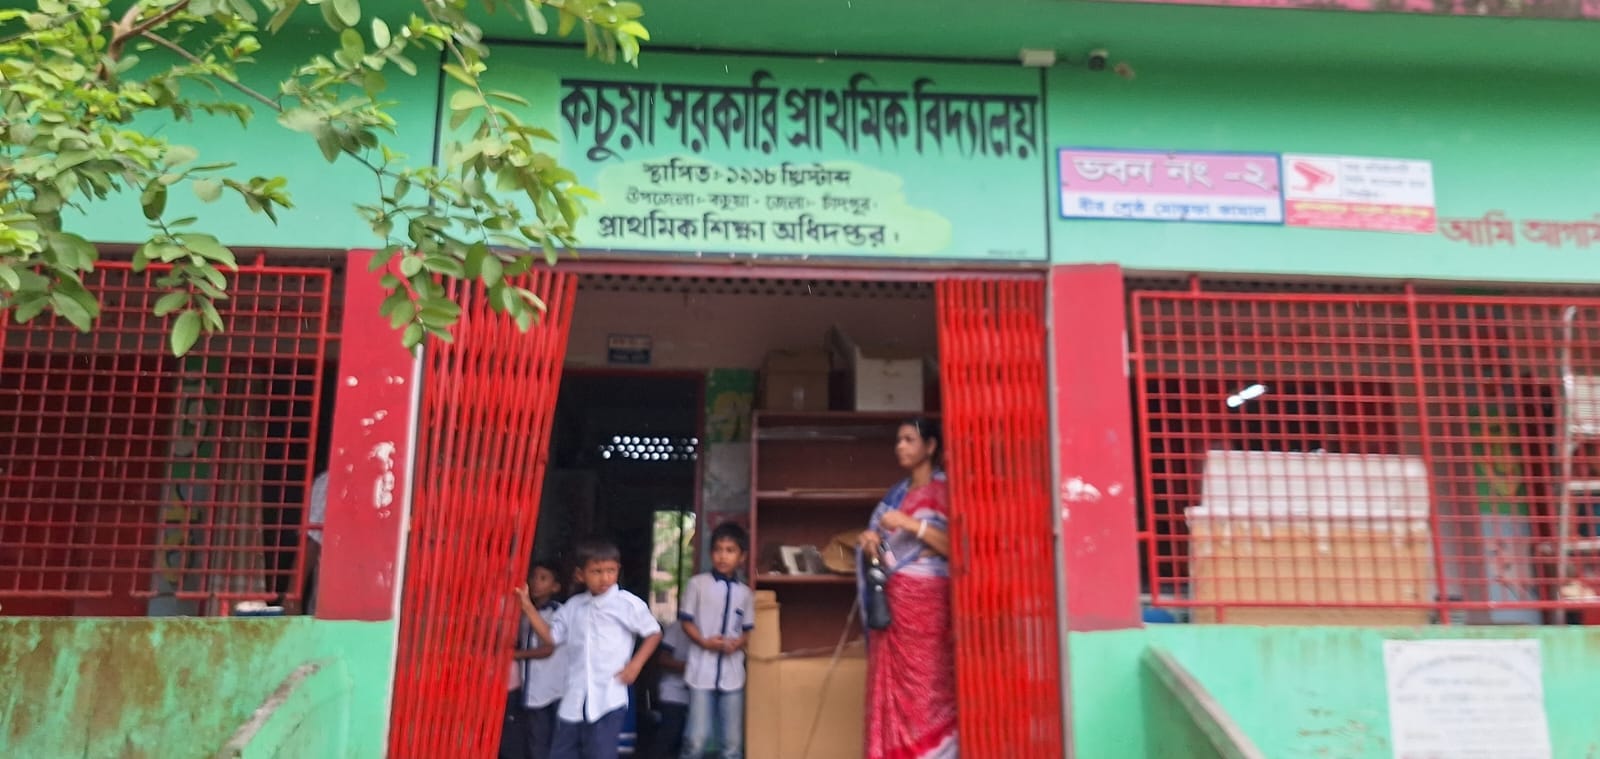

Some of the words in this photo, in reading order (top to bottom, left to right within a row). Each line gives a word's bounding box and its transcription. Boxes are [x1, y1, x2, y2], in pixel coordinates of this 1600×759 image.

[561, 79, 657, 161] কচুয়া
[661, 69, 779, 154] সরকারি
[785, 72, 908, 152] প্রাথমিক
[913, 77, 1039, 159] বিদ্যালয়
[1072, 157, 1154, 186] ভবন
[1163, 159, 1215, 189] নং
[598, 209, 699, 240] প্রাথমিক
[702, 211, 765, 241] শিক্ষা
[1438, 208, 1515, 247] আমি
